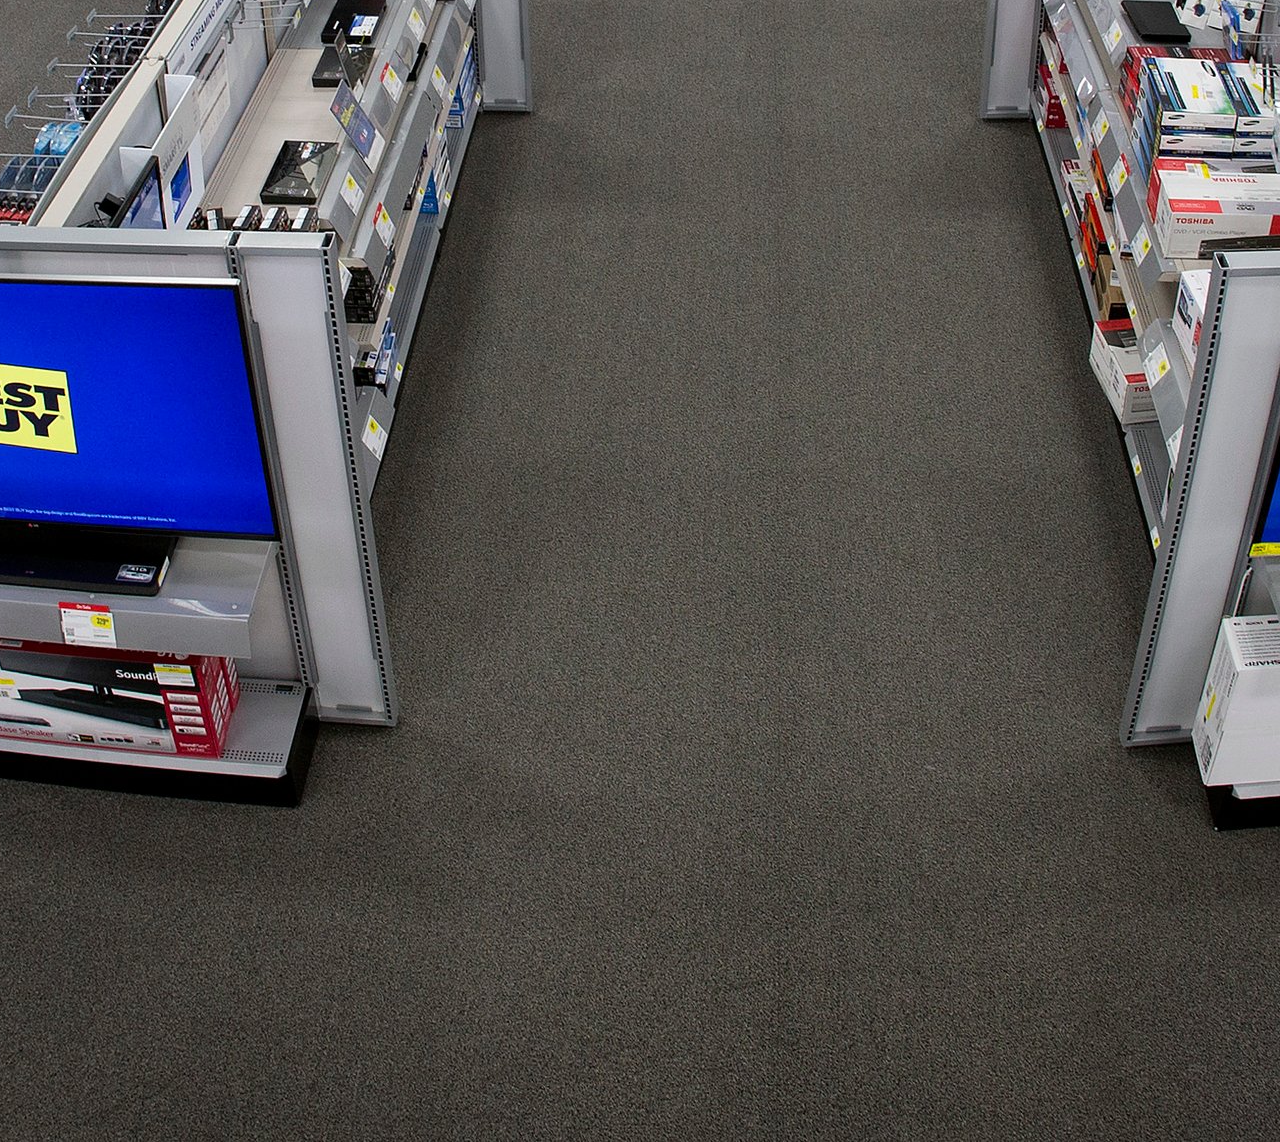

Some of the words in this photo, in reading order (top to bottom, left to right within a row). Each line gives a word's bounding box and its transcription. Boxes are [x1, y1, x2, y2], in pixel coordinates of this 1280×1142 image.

[190, 8, 215, 51] STREAMING
[162, 147, 178, 178] SMART
[1244, 659, 1280, 667] SHARP
[19, 727, 54, 738] Speaker
